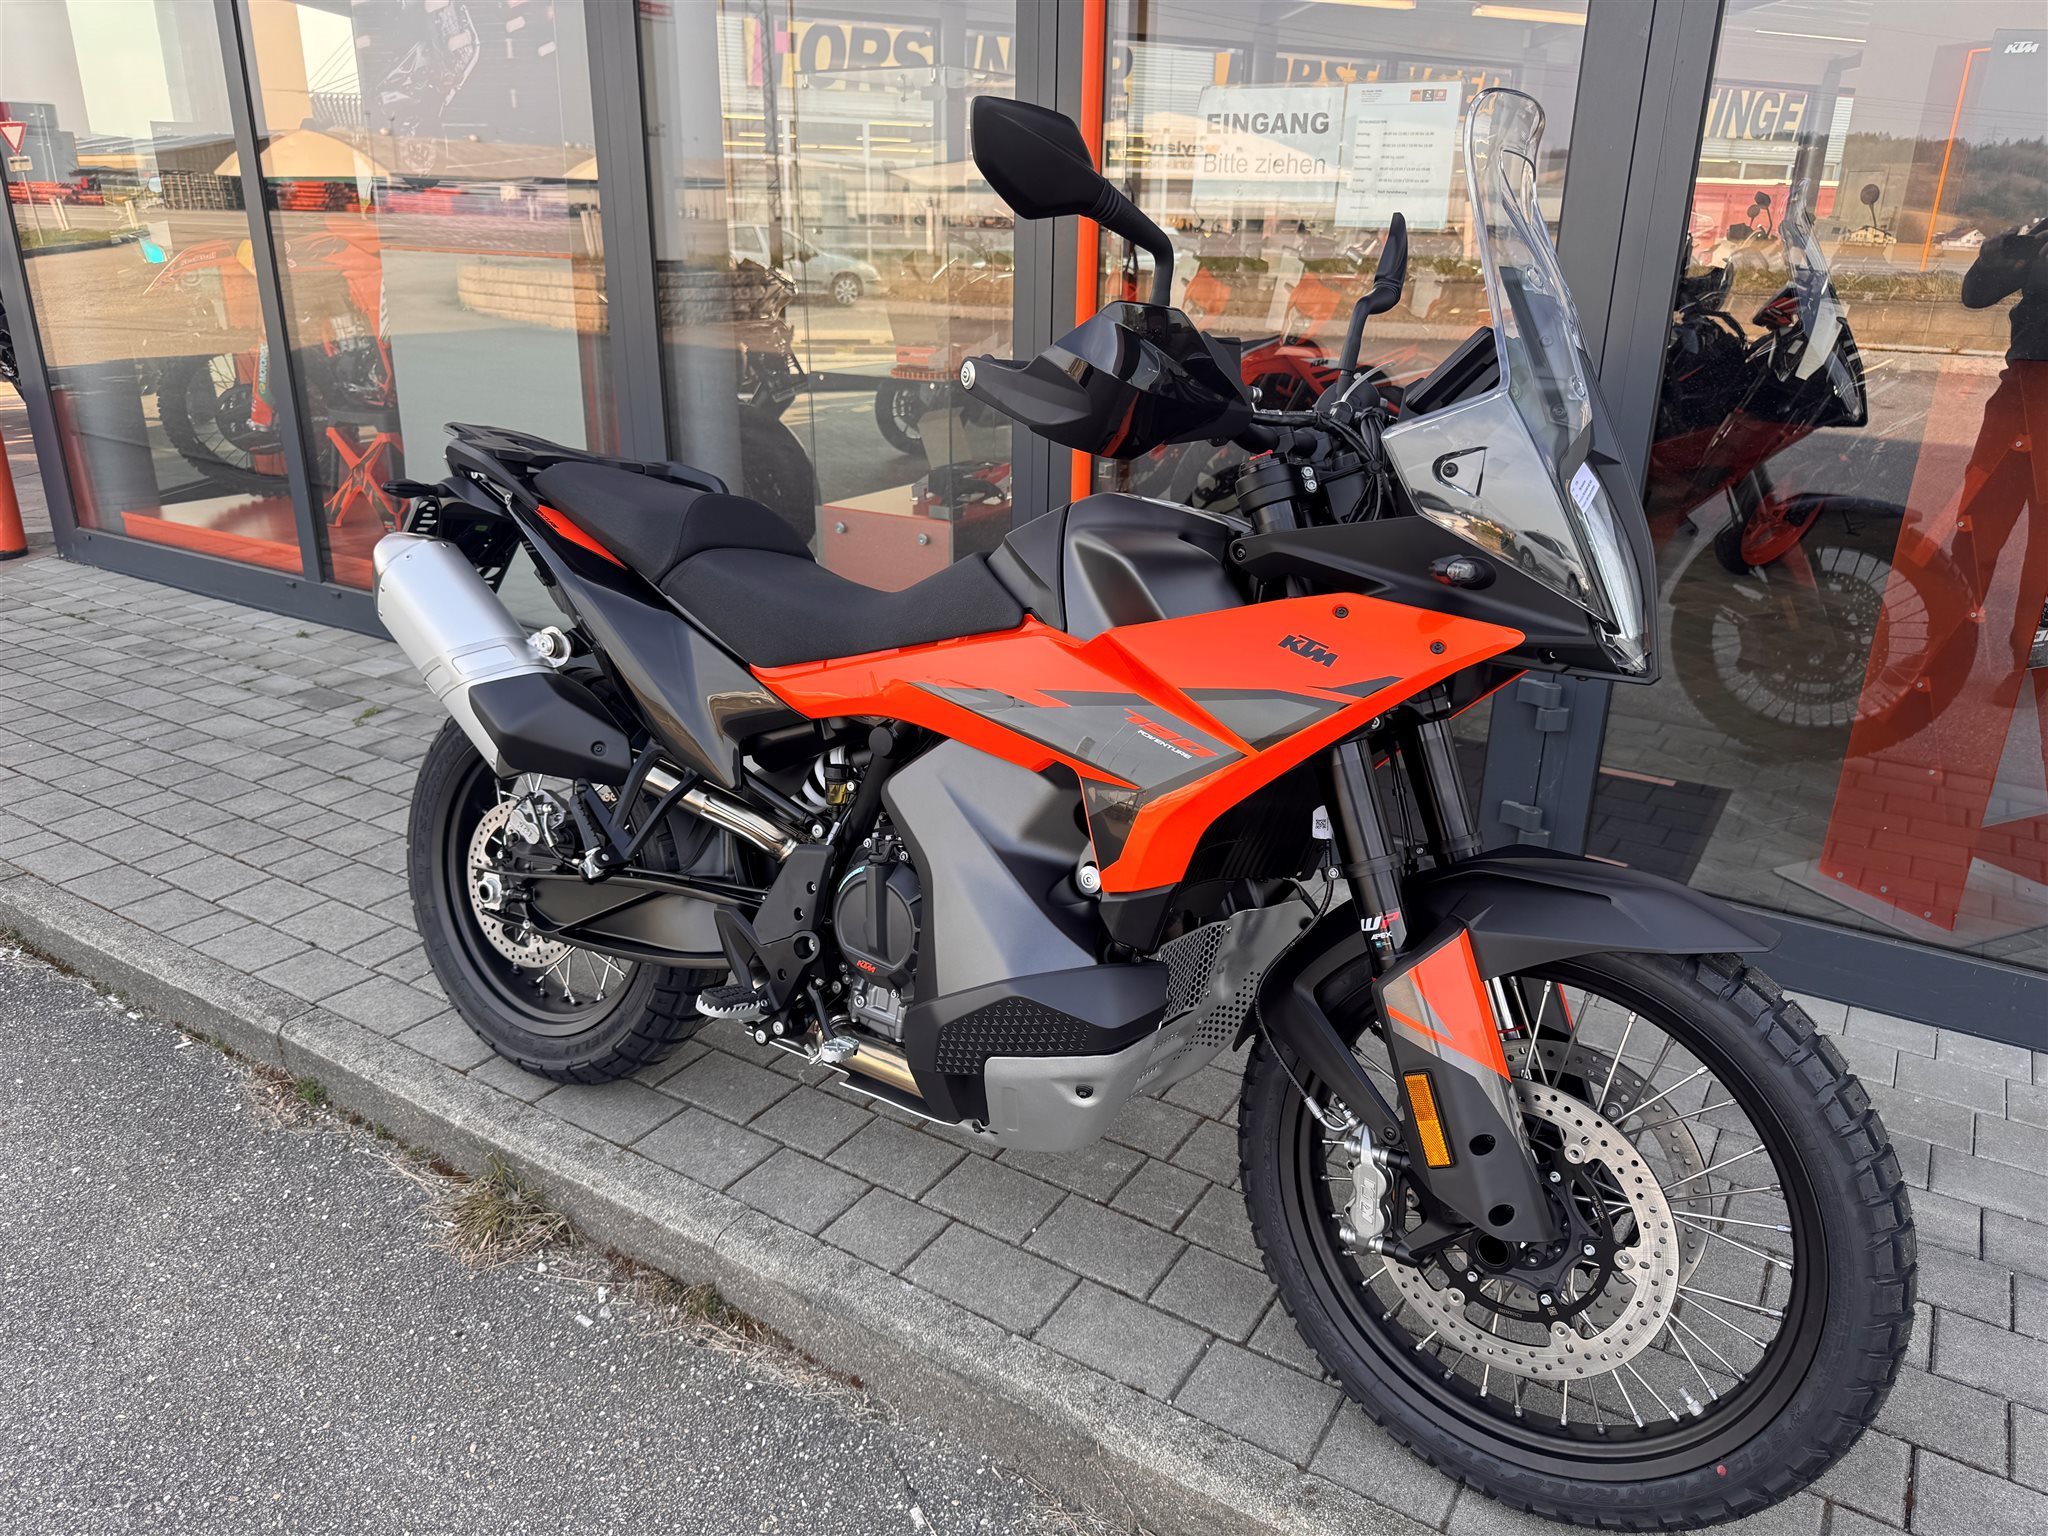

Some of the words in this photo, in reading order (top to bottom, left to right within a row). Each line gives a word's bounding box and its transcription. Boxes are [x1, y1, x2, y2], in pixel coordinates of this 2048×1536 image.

[2004, 41, 2040, 54] KTM
[1206, 112, 1330, 135] EINGANG
[1203, 153, 1248, 174] Bitte
[1255, 152, 1326, 175] ziehen
[1278, 634, 1338, 668] KTM
[1123, 707, 1219, 758] 790
[1137, 729, 1193, 760] ADVENTURE
[1360, 911, 1400, 932] WP
[856, 959, 877, 973] KTM
[1360, 1176, 1377, 1224] KTM
